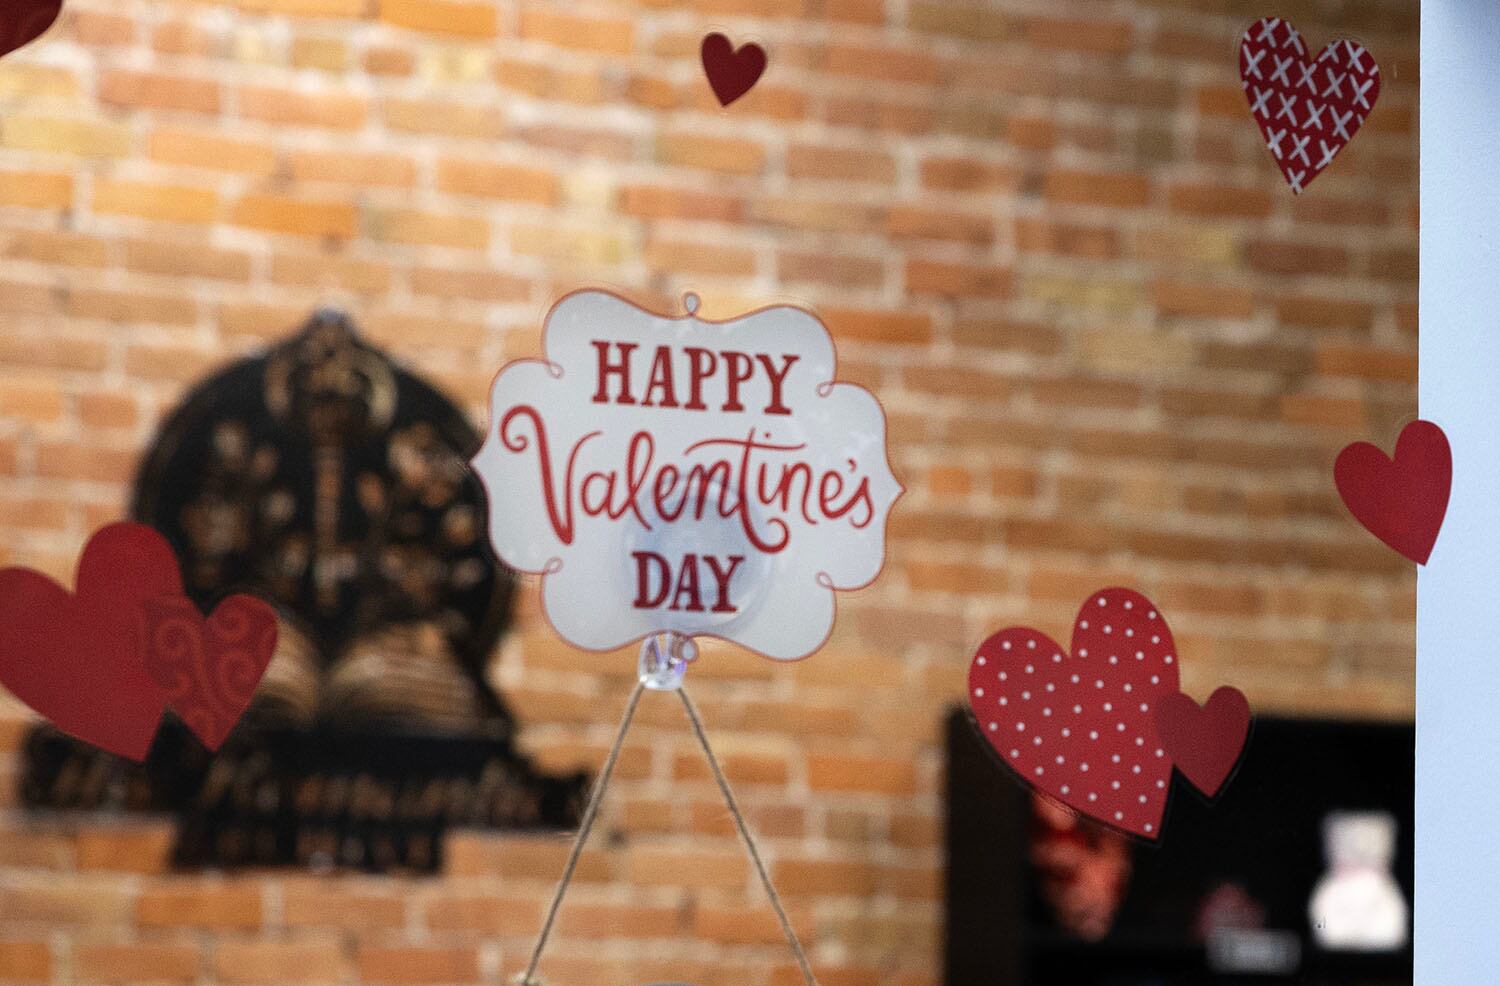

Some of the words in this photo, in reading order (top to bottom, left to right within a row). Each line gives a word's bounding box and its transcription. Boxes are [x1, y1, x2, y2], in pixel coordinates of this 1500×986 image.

[592, 341, 799, 415] HAPPY
[500, 404, 875, 555] Valentine's
[634, 552, 746, 615] DAY
